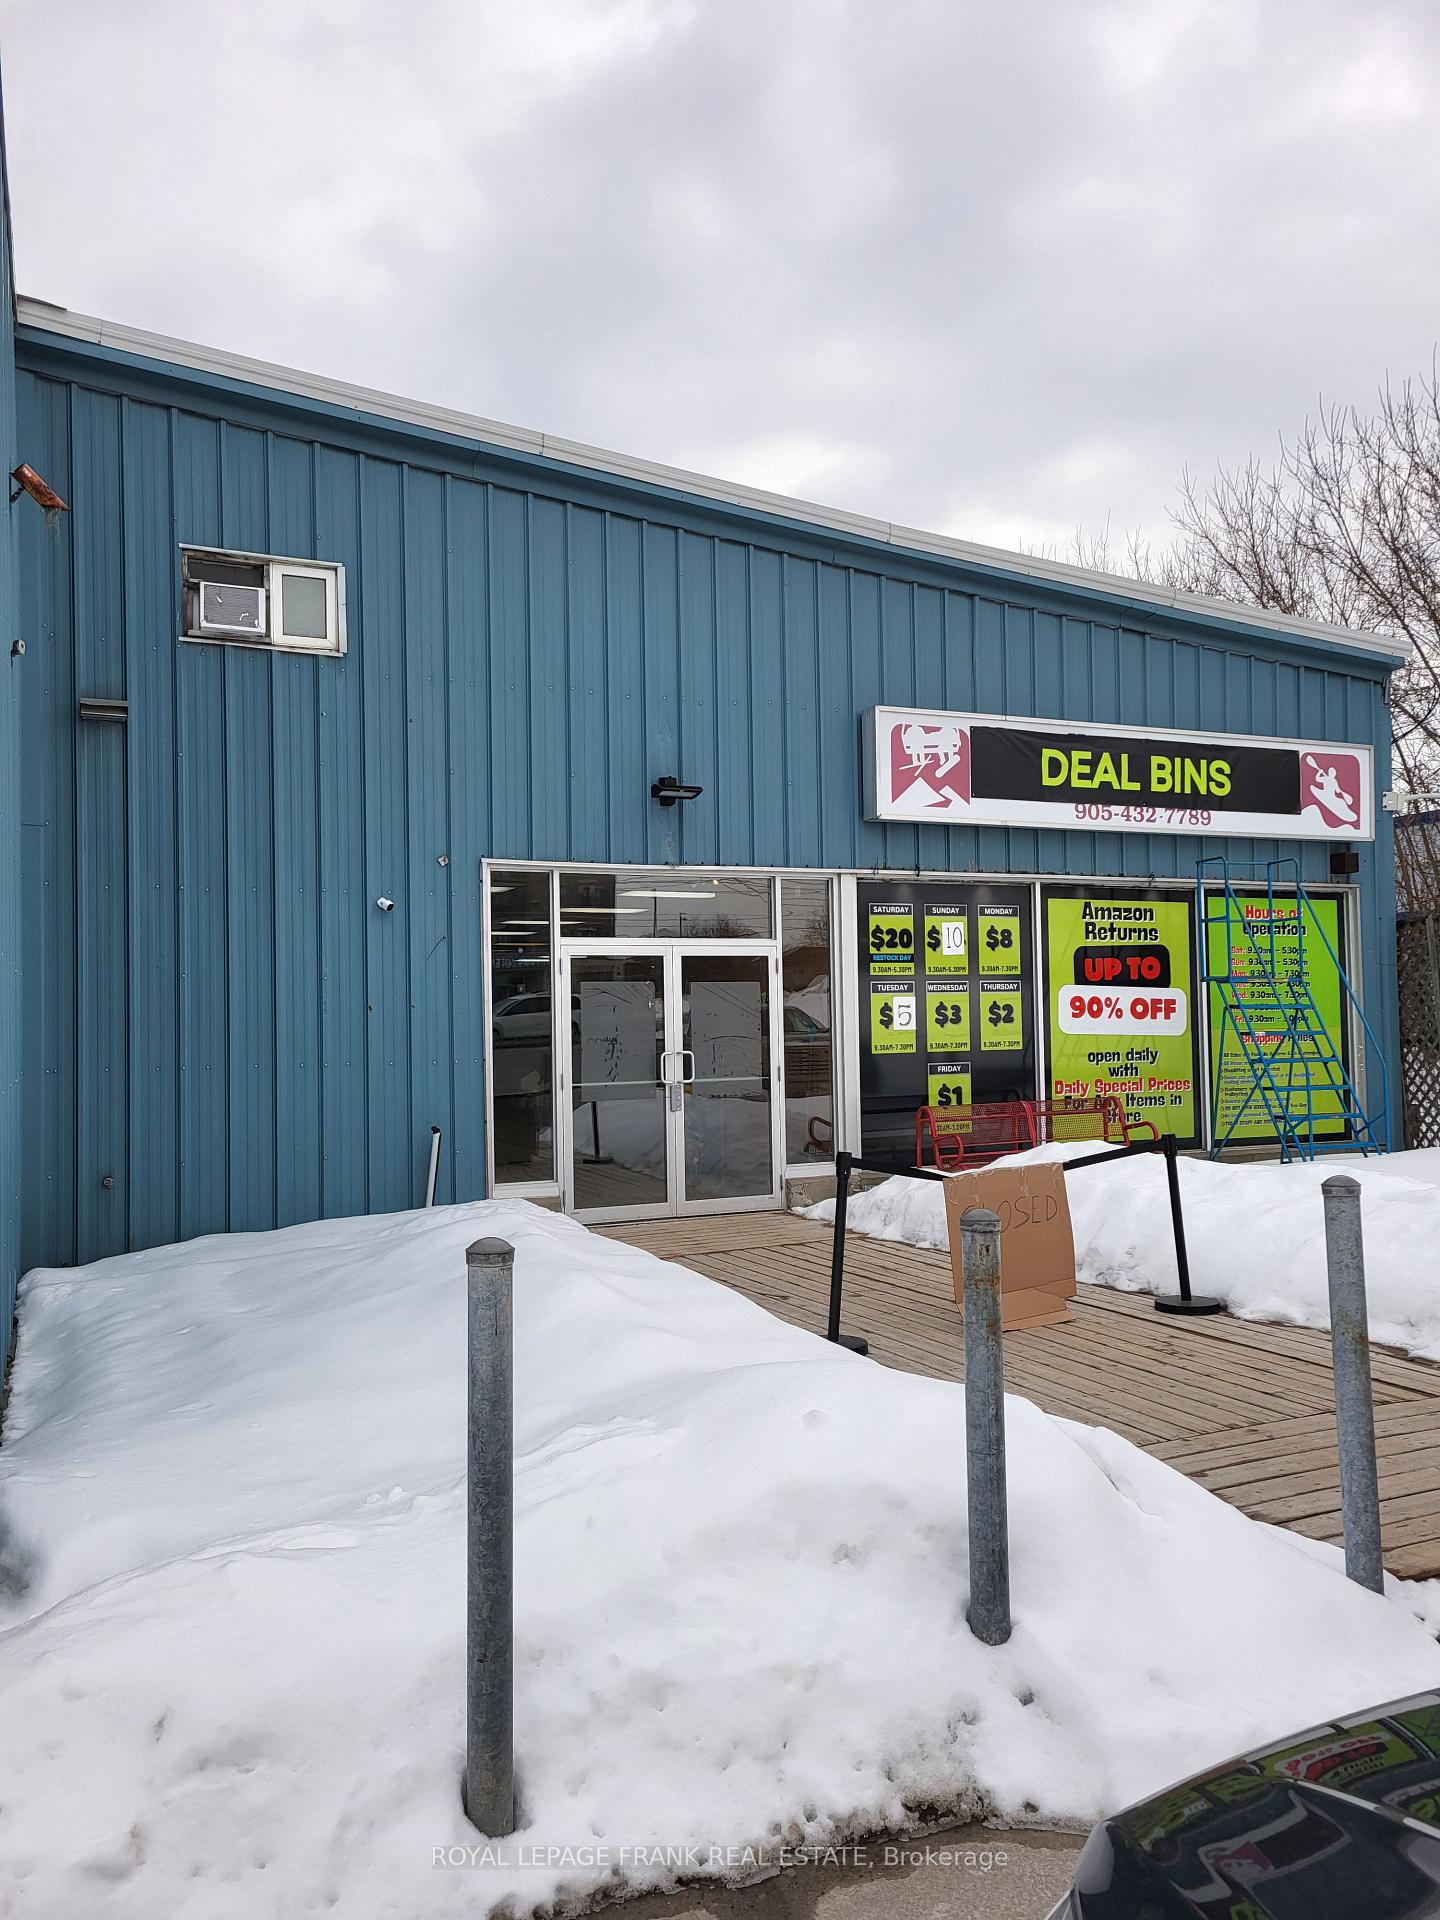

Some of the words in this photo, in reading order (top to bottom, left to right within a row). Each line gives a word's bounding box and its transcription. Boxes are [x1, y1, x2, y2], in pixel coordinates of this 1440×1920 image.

[1041, 748, 1140, 791] DEAL
[1150, 755, 1231, 797] BINS
[932, 906, 960, 914] SUNDAY
[1082, 902, 1155, 921] Amazon
[871, 925, 912, 951] $20
[986, 925, 1012, 951] $8
[1085, 922, 1159, 941] Returns
[1084, 957, 1122, 981] UP
[1126, 956, 1161, 980] TO
[877, 984, 908, 992] TUESDAY
[984, 983, 1018, 991] THURSDAY
[935, 1001, 962, 1028] $3
[988, 1001, 1014, 1027] $2
[1070, 996, 1123, 1019] 90%
[1130, 997, 1176, 1020] OFF
[1088, 1050, 1120, 1066] open
[1126, 1048, 1158, 1064] daily
[1109, 1063, 1140, 1077] with
[938, 1083, 962, 1107] $1
[1055, 1080, 1090, 1098] Daily
[1095, 1077, 1143, 1095] Special
[1148, 1077, 1190, 1091] Prices
[1126, 1094, 1165, 1107] Items
[1170, 1094, 1183, 1106] in
